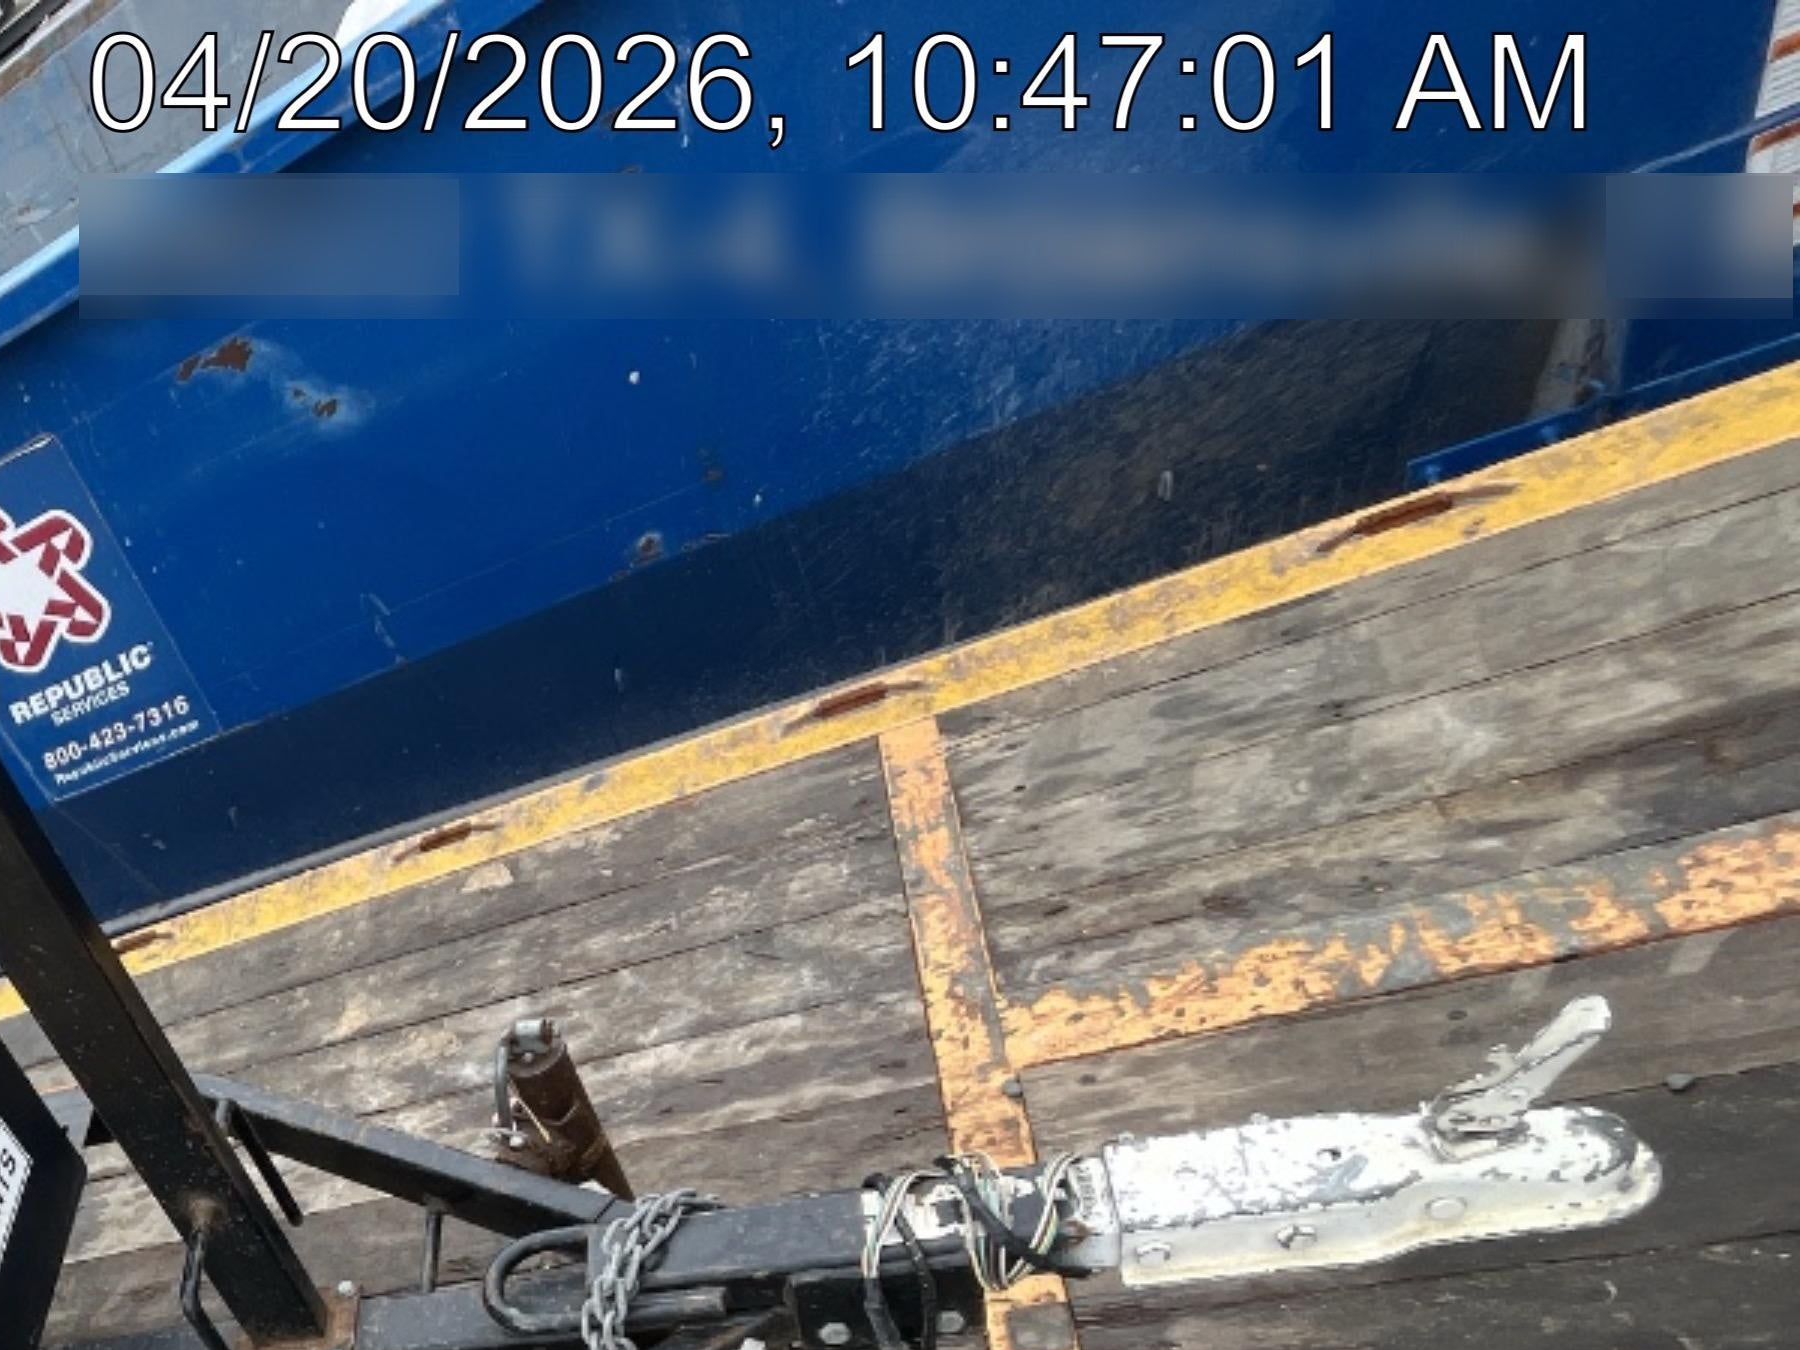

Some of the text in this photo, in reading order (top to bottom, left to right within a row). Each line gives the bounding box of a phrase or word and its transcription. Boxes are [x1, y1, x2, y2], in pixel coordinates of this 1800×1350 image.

[8, 643, 153, 724] REPUBLIC
[50, 681, 130, 727] SERVICES
[43, 695, 190, 770] 800-423-7316
